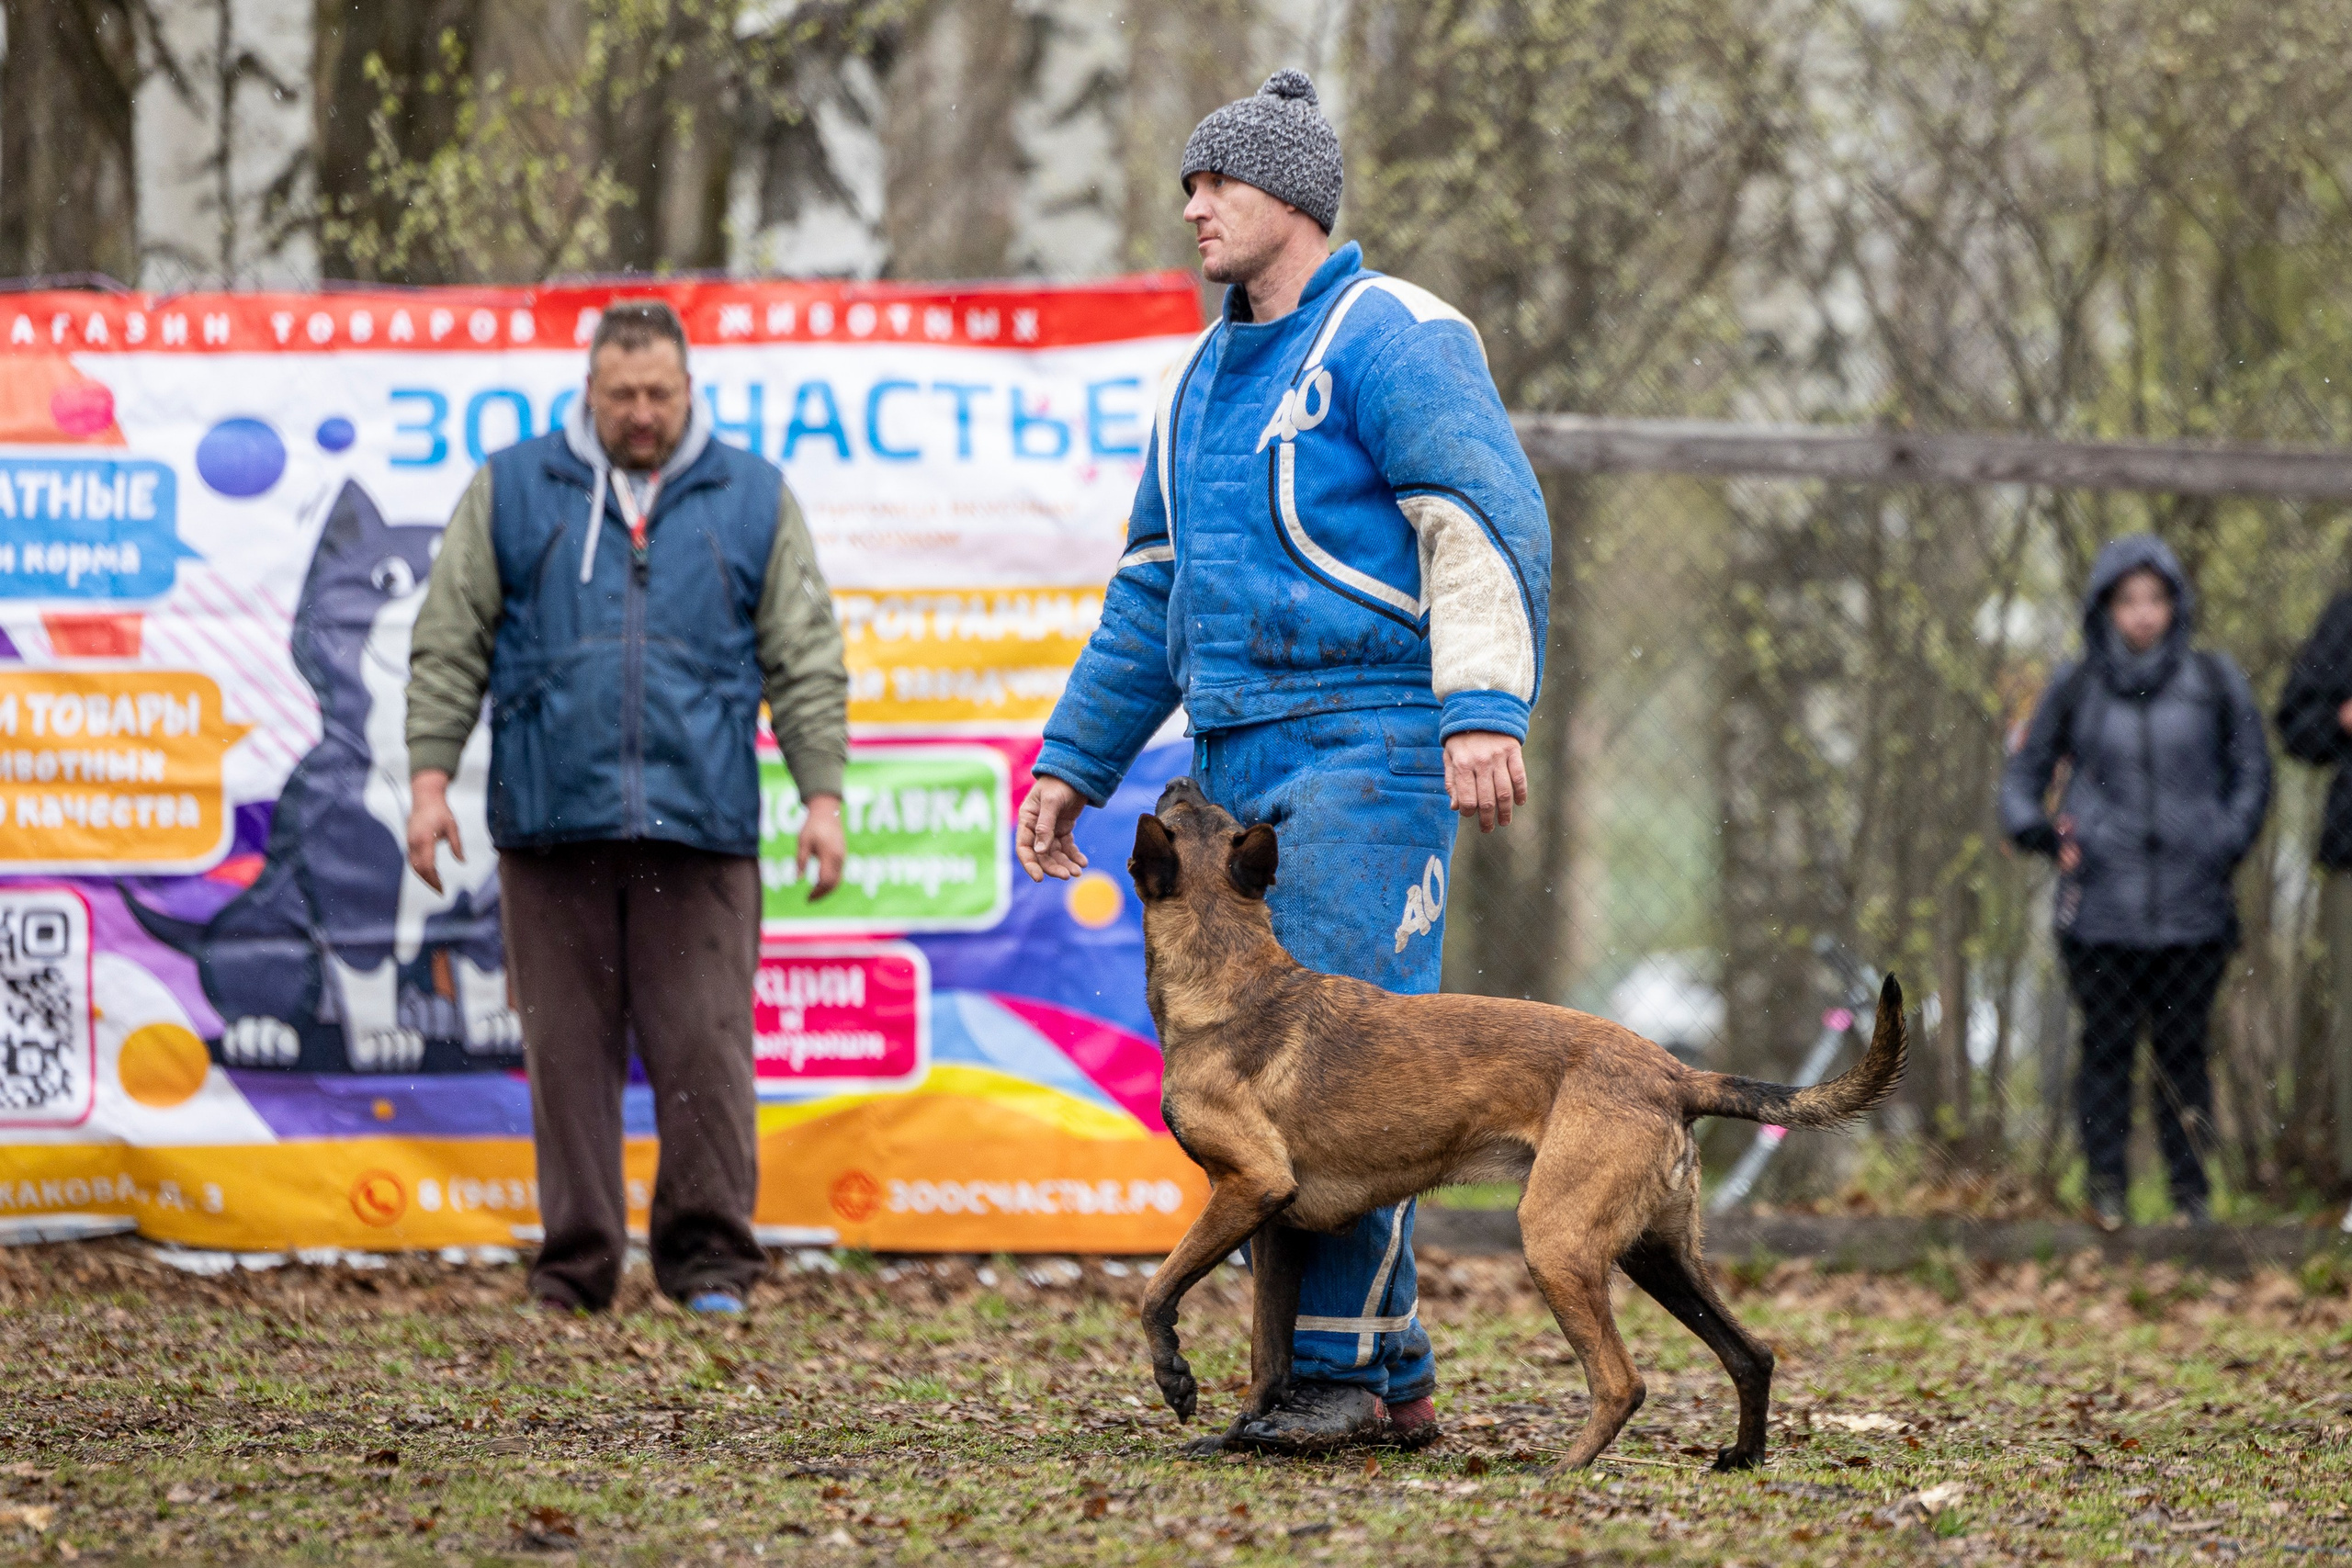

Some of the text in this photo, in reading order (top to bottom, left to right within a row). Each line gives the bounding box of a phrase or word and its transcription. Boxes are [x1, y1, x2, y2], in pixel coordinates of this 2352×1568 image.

[10, 312, 231, 345] АГАЗИН
[272, 310, 537, 344] ТОВАРОВ
[718, 301, 1039, 344] ЖИВОТНЫХ
[389, 377, 1143, 469] ЗОЧАСТЬЕ
[25, 692, 200, 737] ТОВАРЫ
[15, 793, 199, 829] КАЧЕСТВА
[760, 785, 992, 841] ОТАВКА
